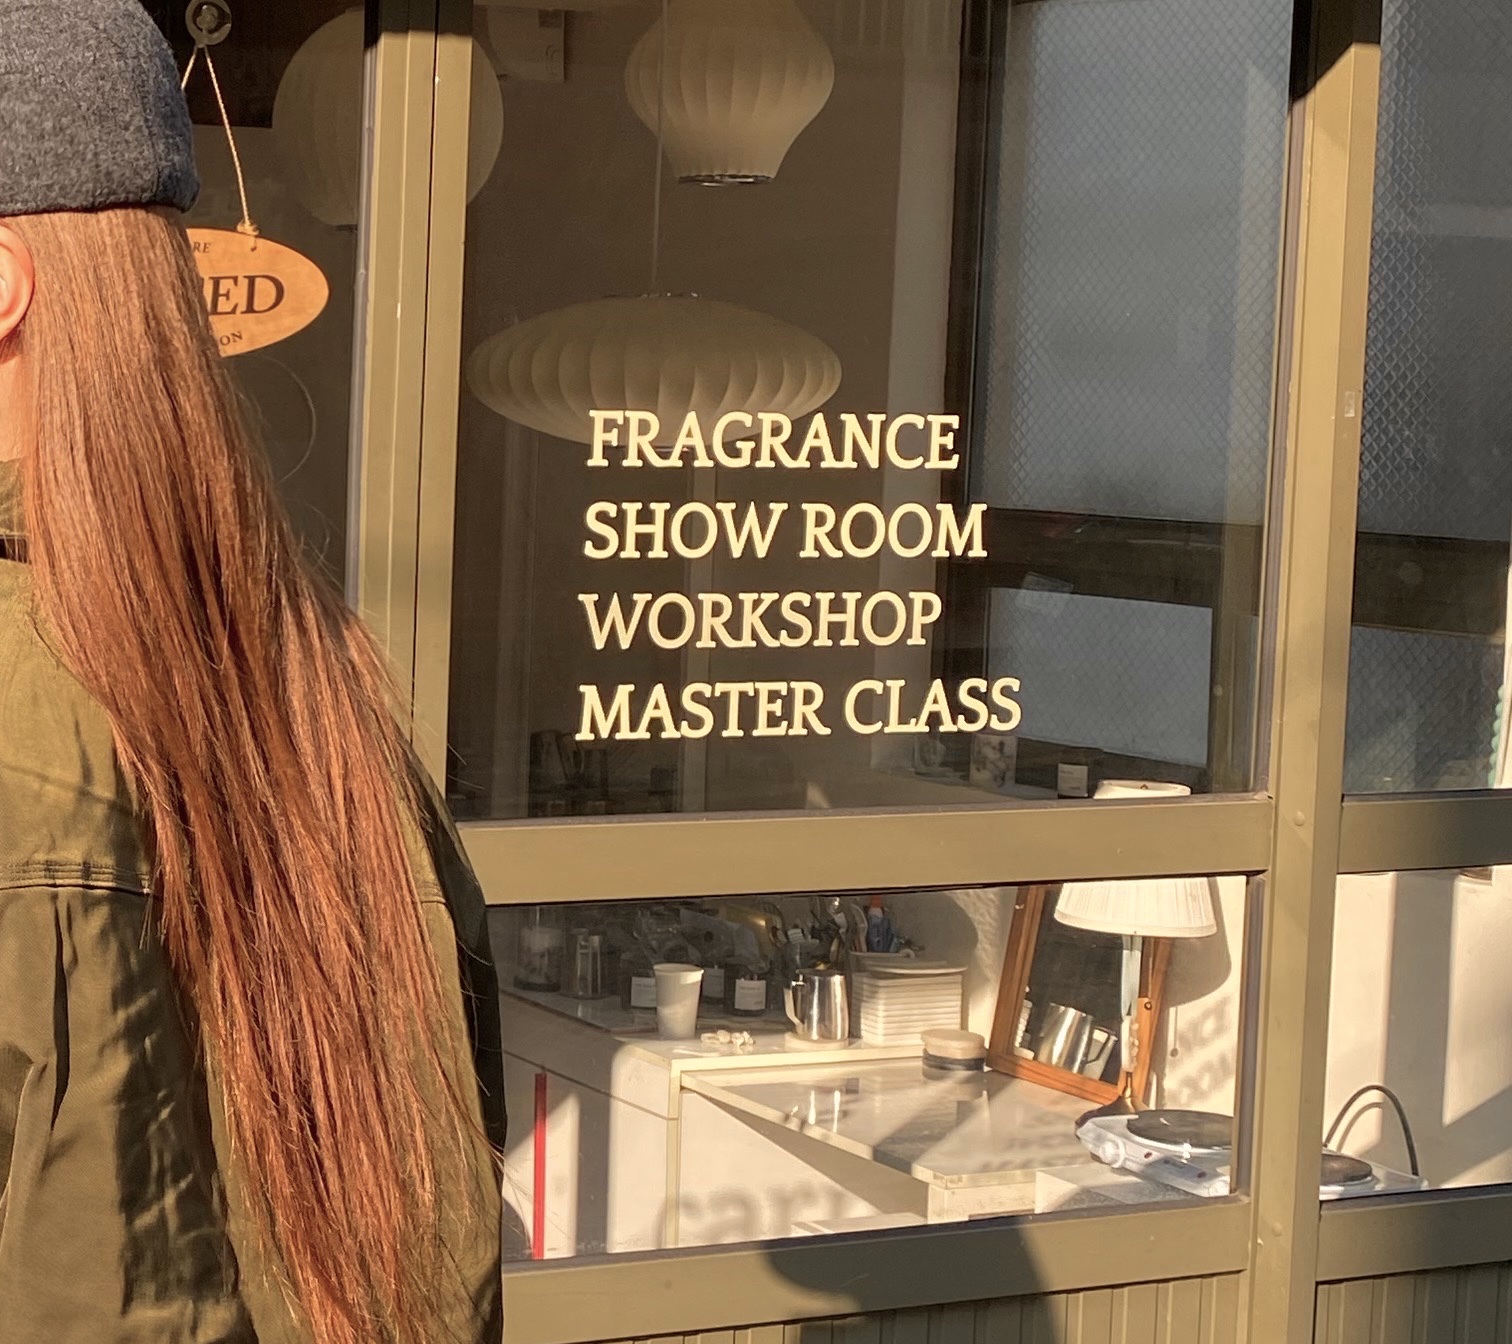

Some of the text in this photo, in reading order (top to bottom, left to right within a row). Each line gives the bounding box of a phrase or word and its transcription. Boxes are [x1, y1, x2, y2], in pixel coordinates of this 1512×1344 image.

[192, 241, 212, 254] RE
[208, 274, 285, 317] ED
[219, 330, 244, 347] ON
[586, 409, 961, 470] FRAGRANCE
[584, 501, 988, 559] SHOW ROOM
[578, 590, 942, 650] WORKSHOP
[575, 677, 1023, 741] MASTER CLASS
